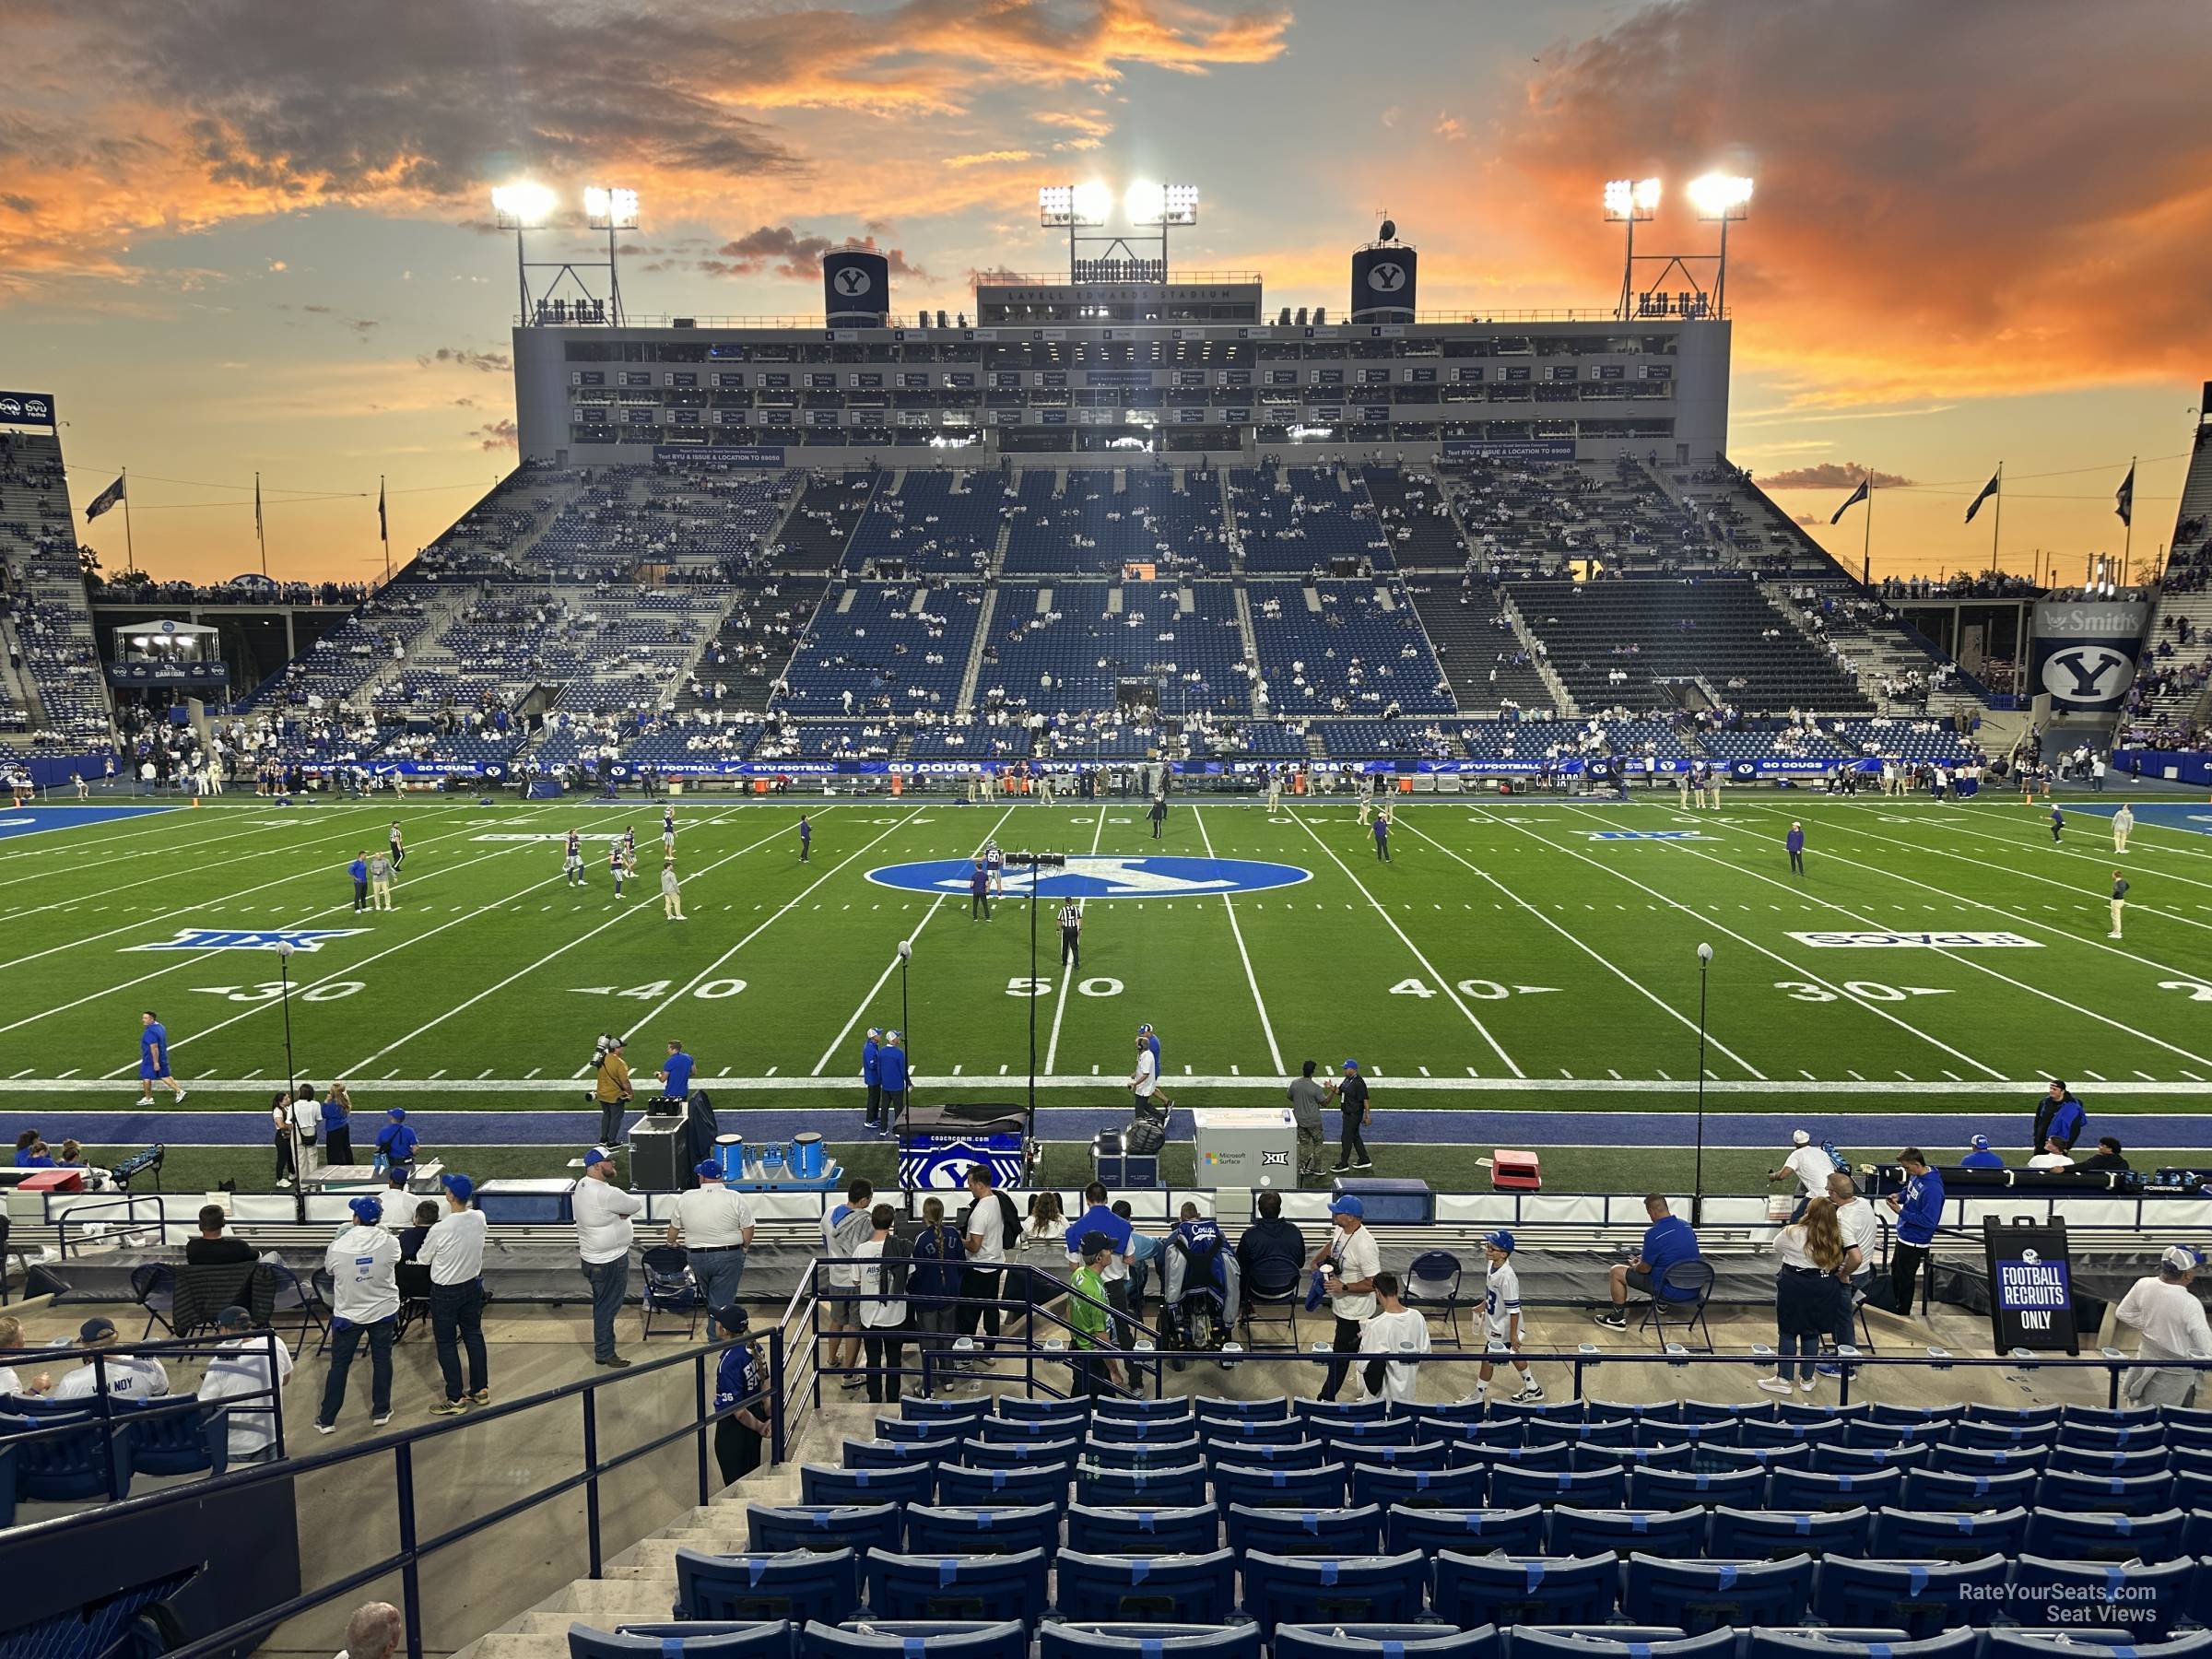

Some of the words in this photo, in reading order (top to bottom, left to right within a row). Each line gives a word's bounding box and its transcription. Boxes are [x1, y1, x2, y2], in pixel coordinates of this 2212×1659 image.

[840, 270, 864, 292] Y
[1374, 265, 1399, 288] Y
[25, 403, 47, 413] byu
[2071, 610, 2140, 631] Smith's
[2054, 653, 2122, 696] Y
[888, 763, 915, 772] GO
[917, 763, 982, 772] COUGS
[987, 853, 1000, 862] 60
[228, 981, 368, 1001] 30
[617, 979, 747, 999] 40
[1005, 977, 1124, 997] 50
[1388, 978, 1511, 999] 40
[1773, 981, 1908, 1002] 30
[2157, 981, 2212, 1001] 2
[1263, 1151, 1288, 1165] XII
[2002, 1267, 2062, 1286] FOOTBALL
[2004, 1287, 2065, 1305] RECRUITS
[2020, 1310, 2052, 1330] ONLY
[92, 1382, 112, 1394] VN
[114, 1377, 134, 1392] NOY
[722, 1392, 735, 1402] 36
